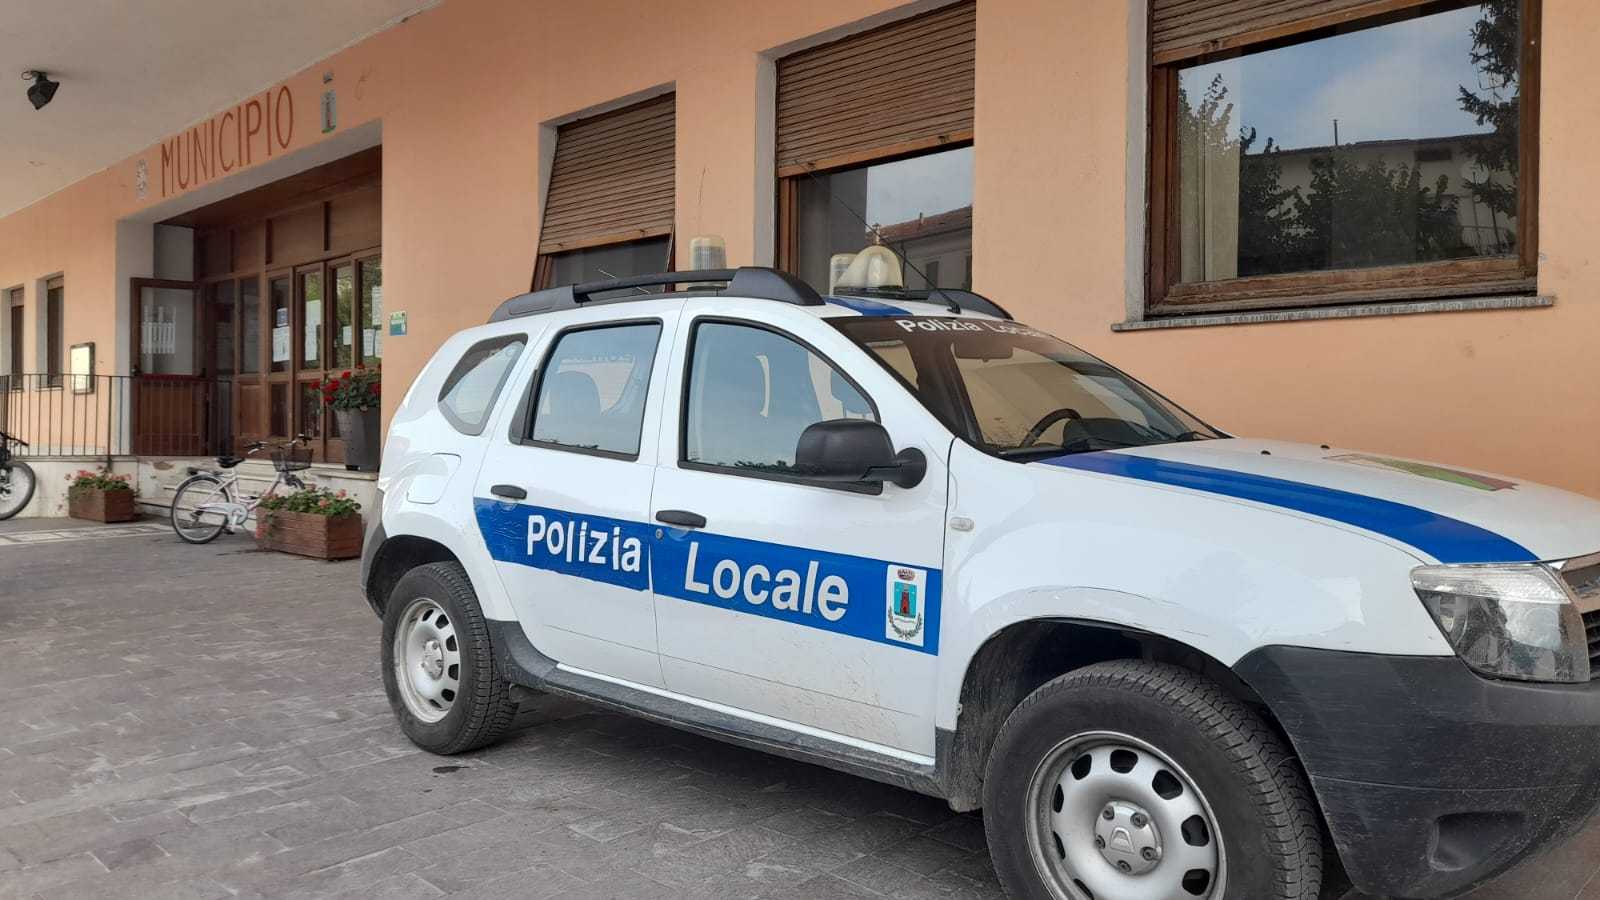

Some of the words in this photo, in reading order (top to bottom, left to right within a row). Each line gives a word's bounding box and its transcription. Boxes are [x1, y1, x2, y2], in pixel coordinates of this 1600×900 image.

[161, 85, 294, 197] MUNICIPIO
[896, 319, 984, 333] Polizia
[526, 514, 642, 572] Polizia
[685, 542, 849, 621] Locale
